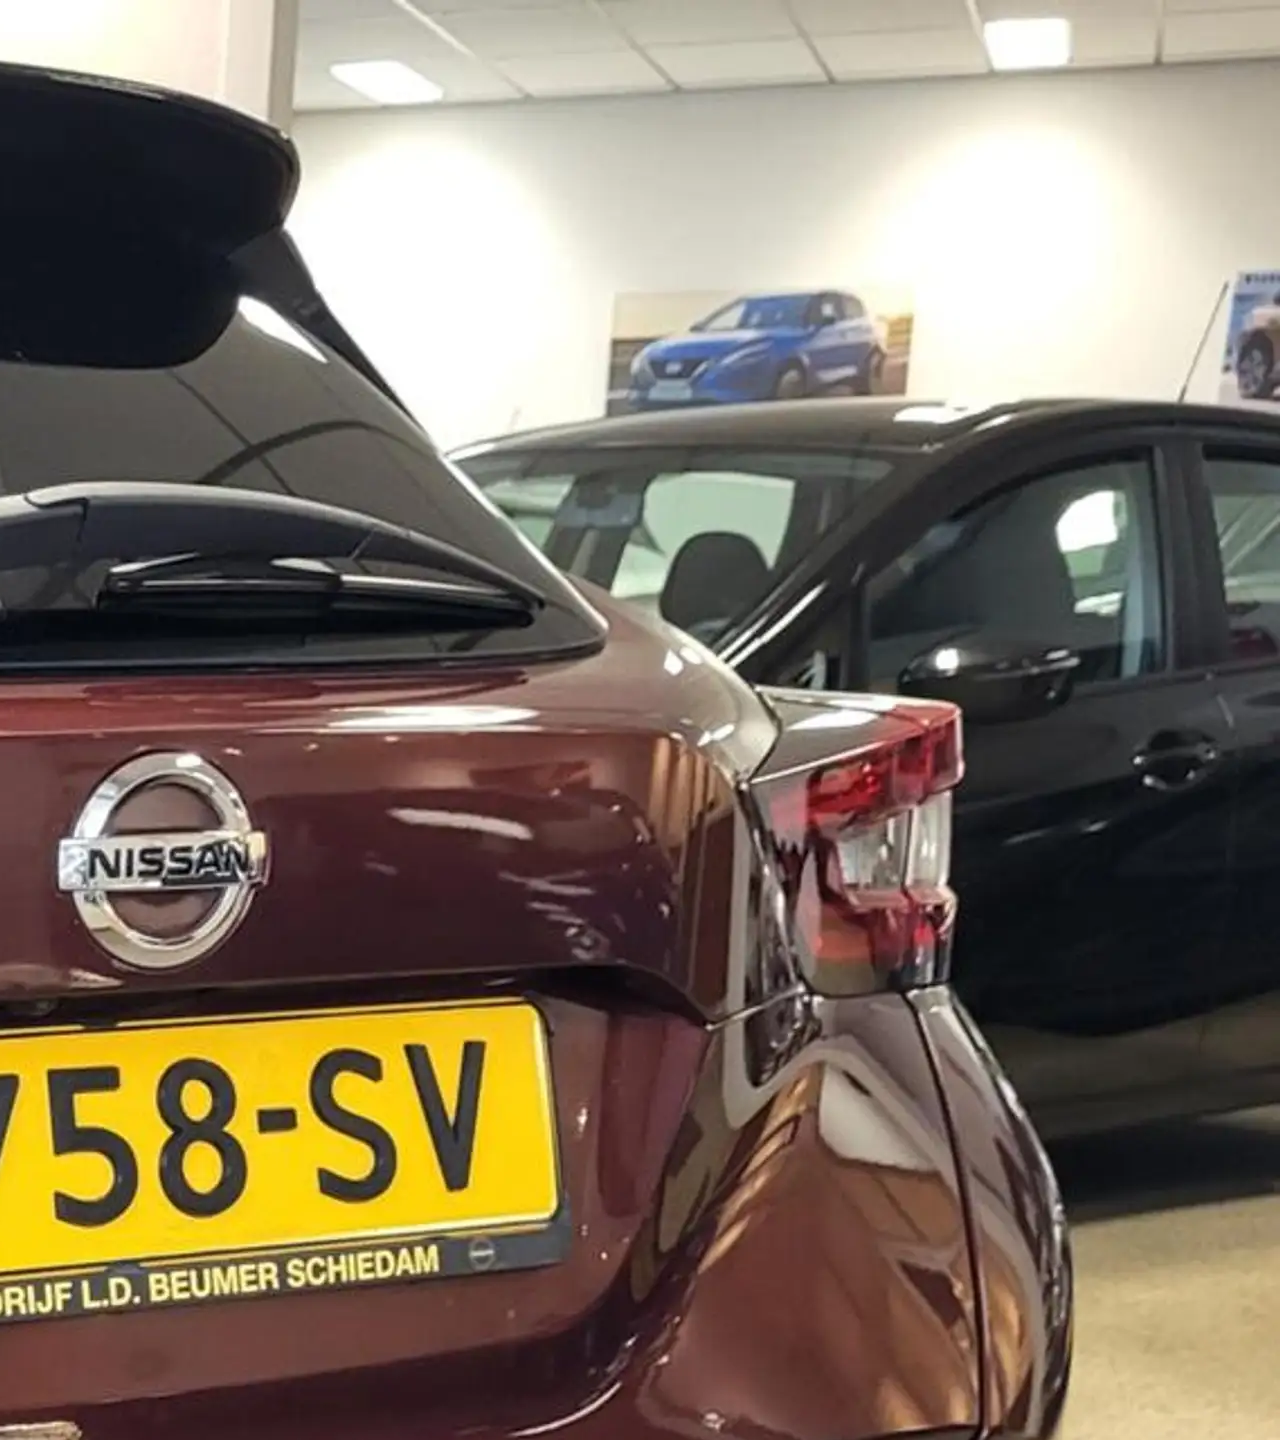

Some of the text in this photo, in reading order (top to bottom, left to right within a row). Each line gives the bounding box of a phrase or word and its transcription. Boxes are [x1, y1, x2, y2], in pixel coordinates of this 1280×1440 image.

[89, 837, 250, 880] NISSAN
[81, 1277, 141, 1310] L.D.
[148, 1261, 279, 1303] BEUMER
[286, 1244, 440, 1289] SCHIEDAM
